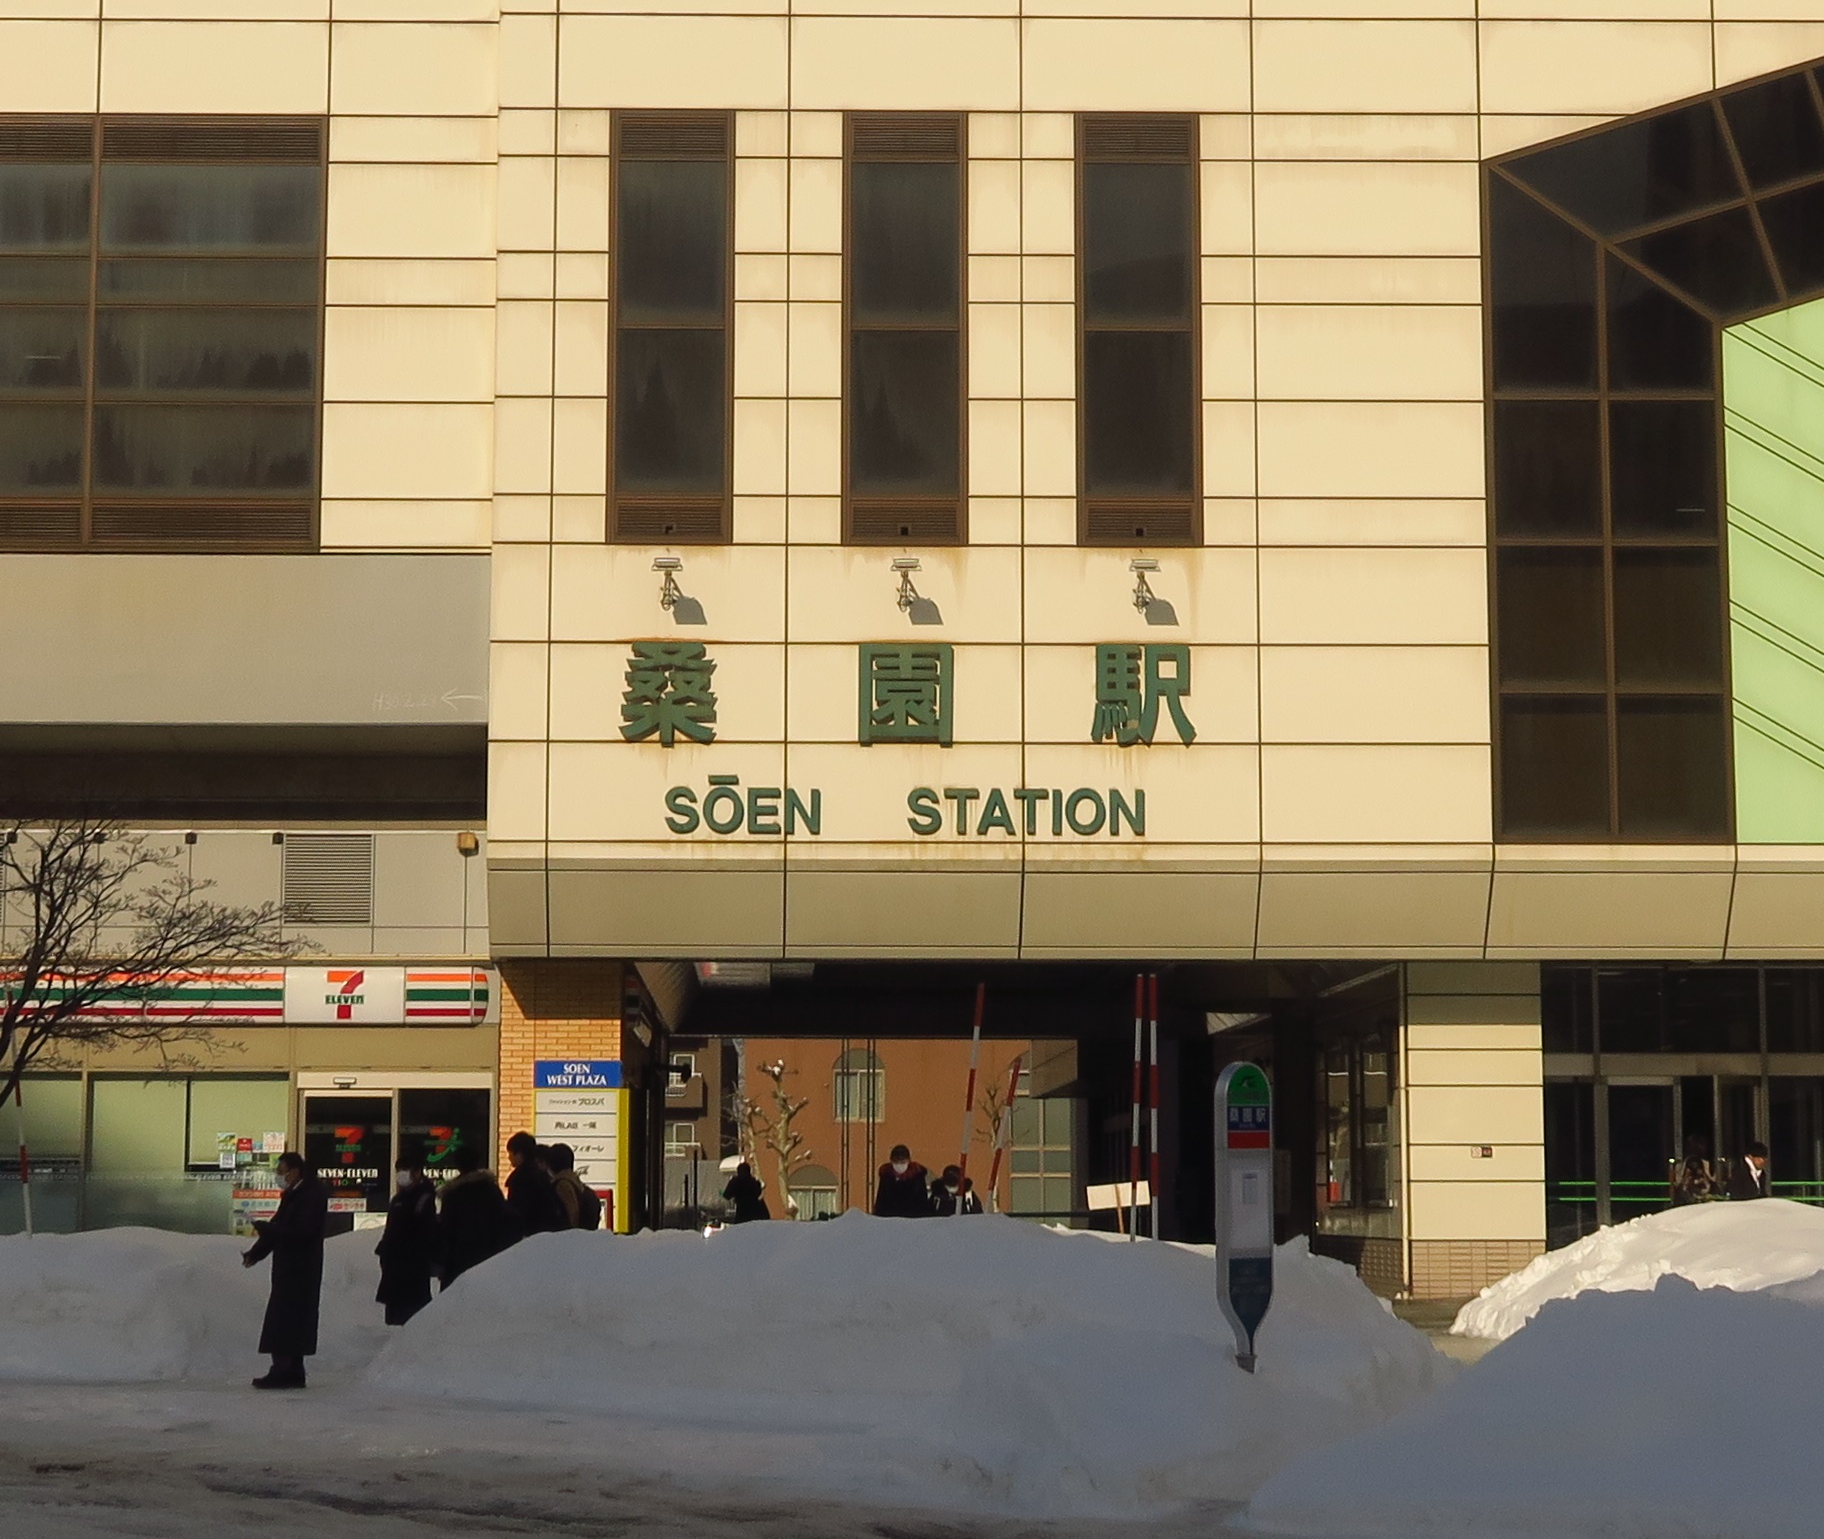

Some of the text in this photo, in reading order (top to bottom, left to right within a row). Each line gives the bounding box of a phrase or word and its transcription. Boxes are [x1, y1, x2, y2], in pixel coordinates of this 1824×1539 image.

[619, 641, 1197, 747] 桑園駅
[664, 774, 1146, 836] SŌEN STATION
[547, 1074, 607, 1085] WEST PLAZA
[563, 1063, 591, 1074] SOEN
